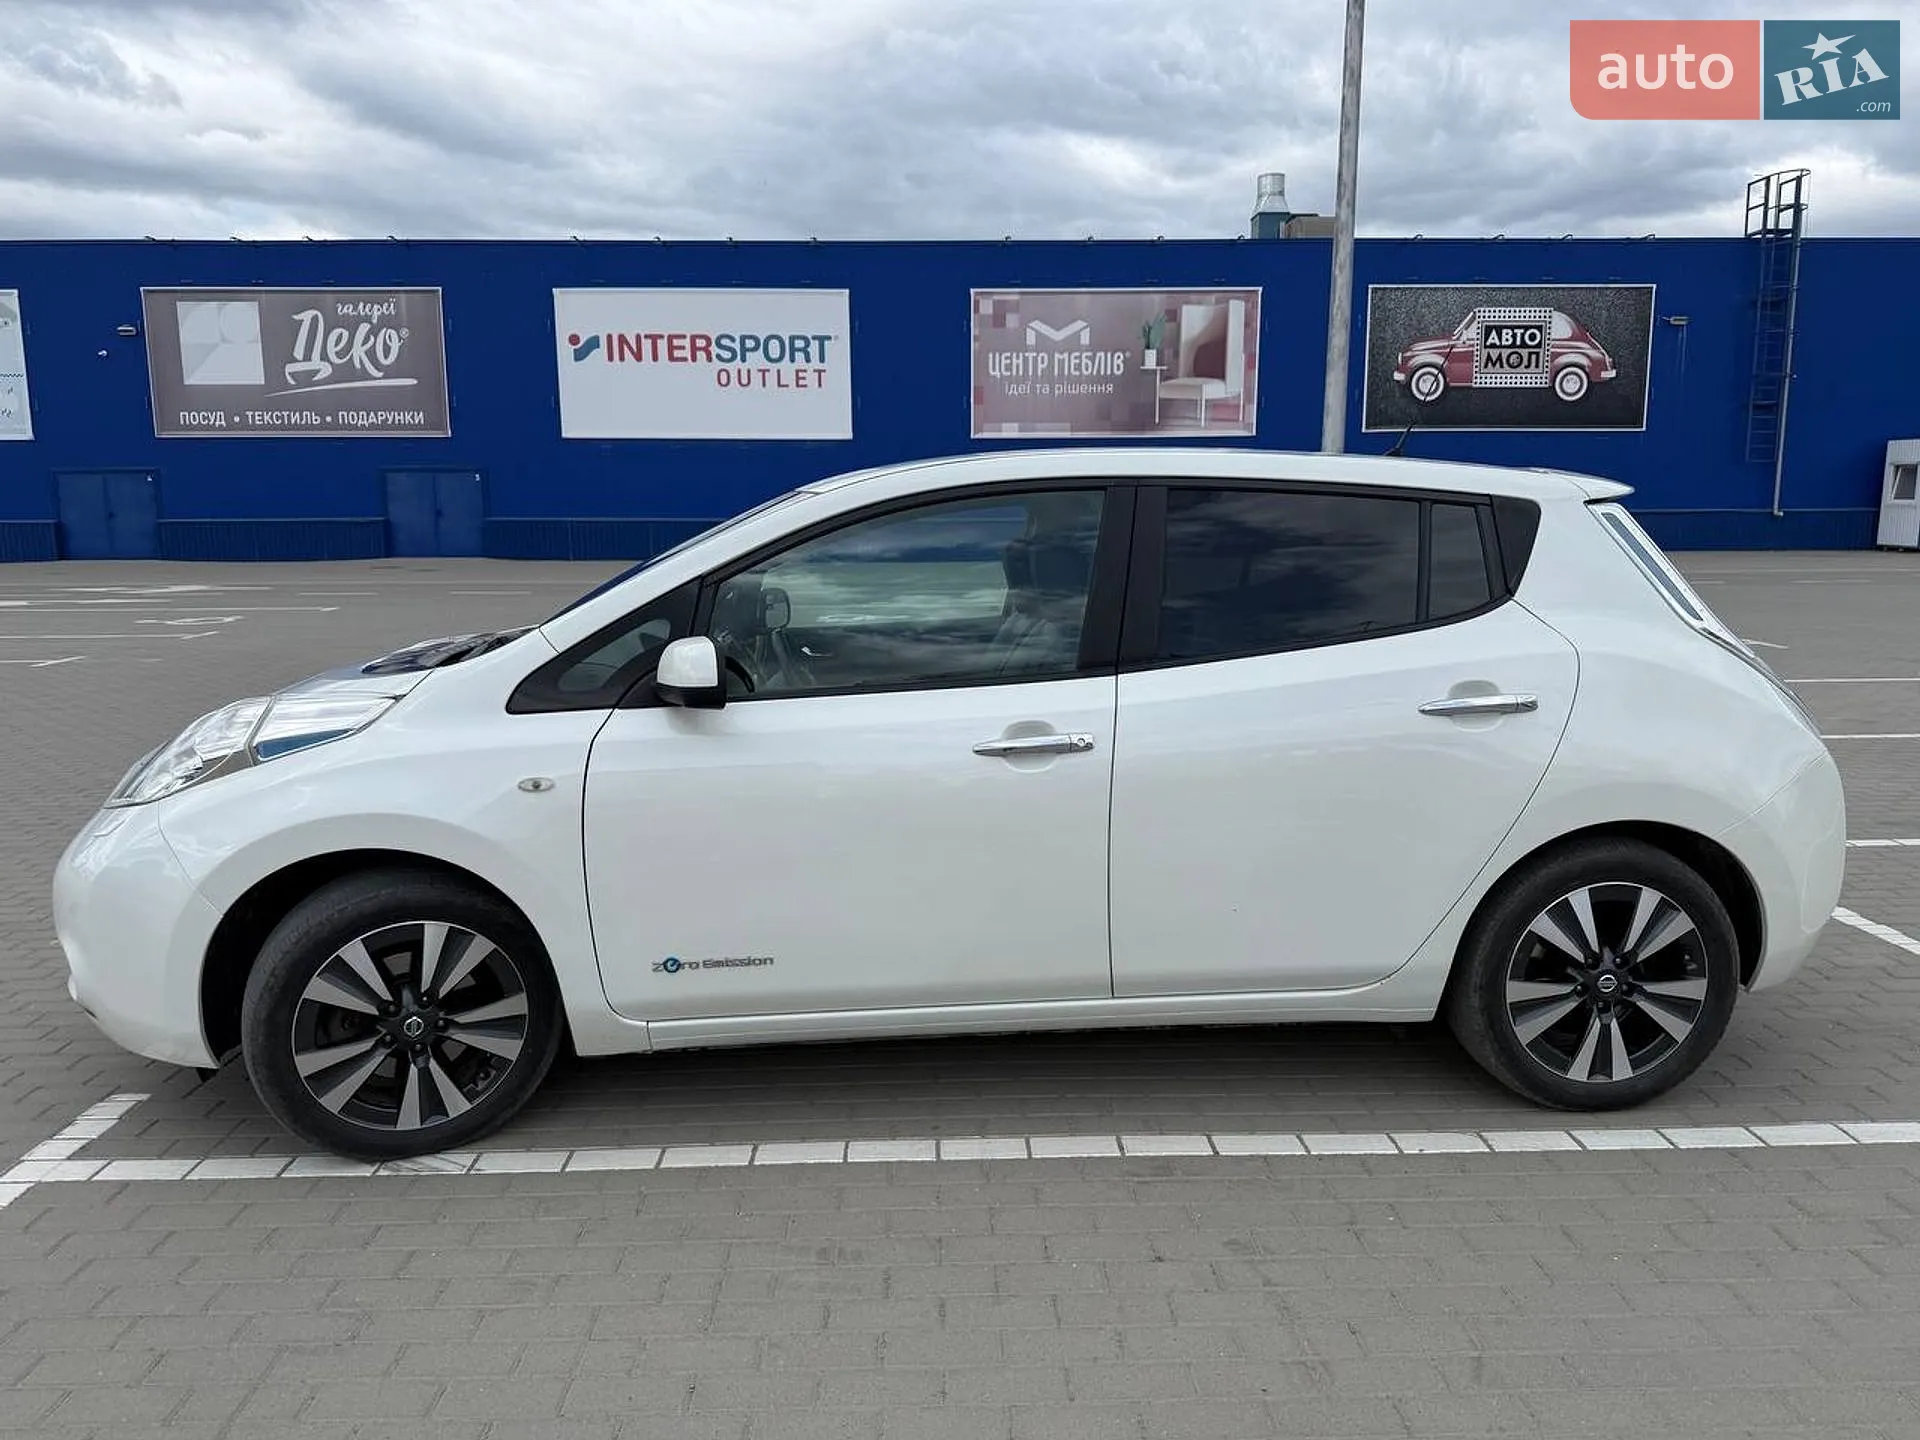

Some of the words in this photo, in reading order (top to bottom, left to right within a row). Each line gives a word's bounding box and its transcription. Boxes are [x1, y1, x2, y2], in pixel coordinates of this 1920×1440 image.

[285, 309, 403, 385] Деко
[1486, 329, 1541, 346] АВТО
[606, 333, 832, 363] INTERSPORT
[988, 351, 1049, 377] ЦЕНТР
[1054, 351, 1125, 376] МЕБЛІВ
[1484, 351, 1541, 369] МОЛ
[717, 368, 827, 388] OUTLET
[1055, 383, 1114, 397] рішення
[179, 411, 226, 427] ПОСУД
[246, 411, 321, 425] ТЕКСТИЛЬ
[338, 411, 424, 427] ПОДАРУНКИ
